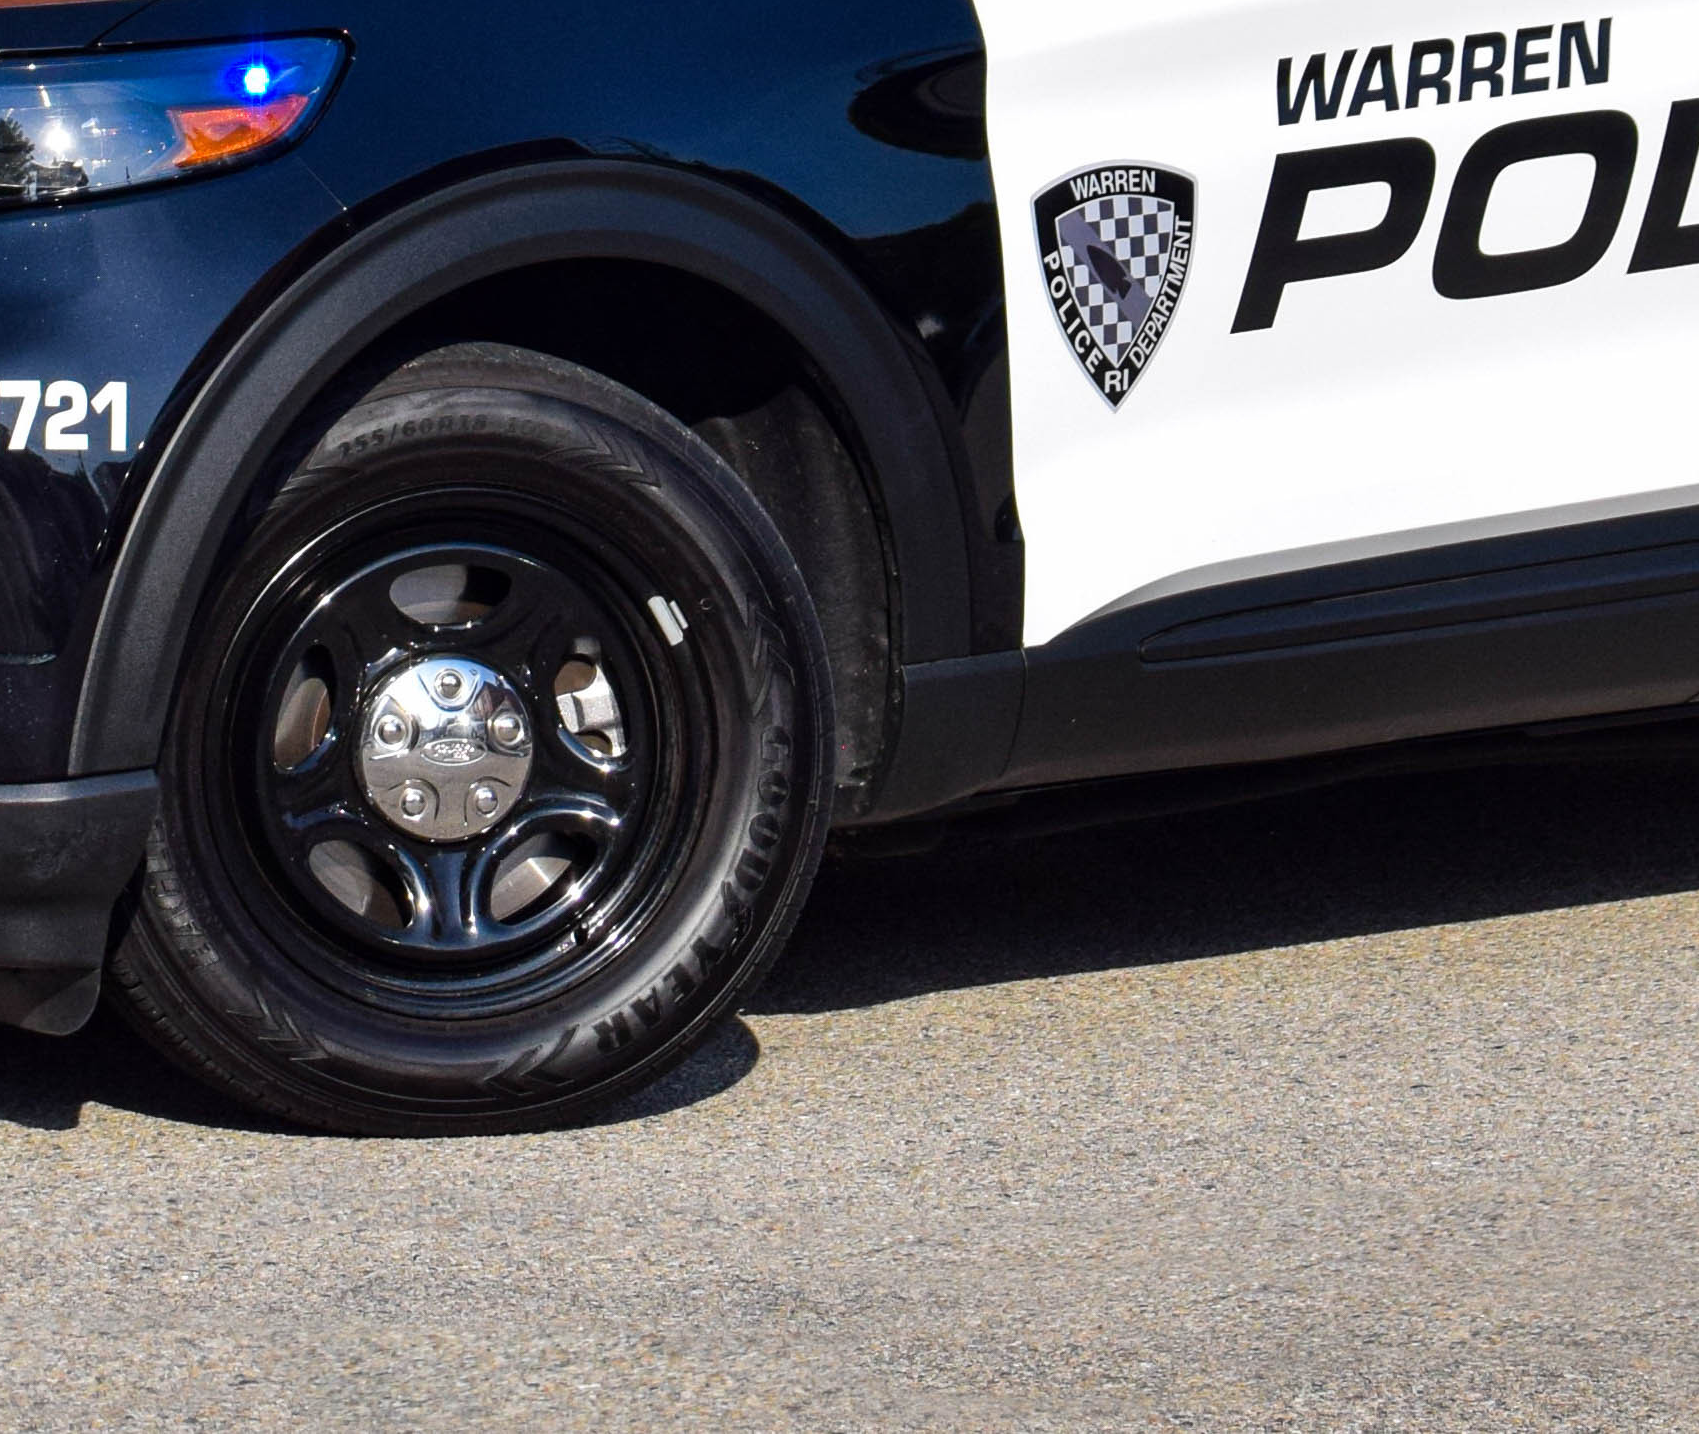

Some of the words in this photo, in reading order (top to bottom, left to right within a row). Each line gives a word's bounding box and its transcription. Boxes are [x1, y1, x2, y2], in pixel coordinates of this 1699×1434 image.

[1277, 18, 1612, 126] WARREN
[1070, 169, 1156, 201] WARREN
[1043, 250, 1103, 374] POLICE
[1129, 215, 1192, 367] DEPARTMENT
[1104, 368, 1129, 393] RI
